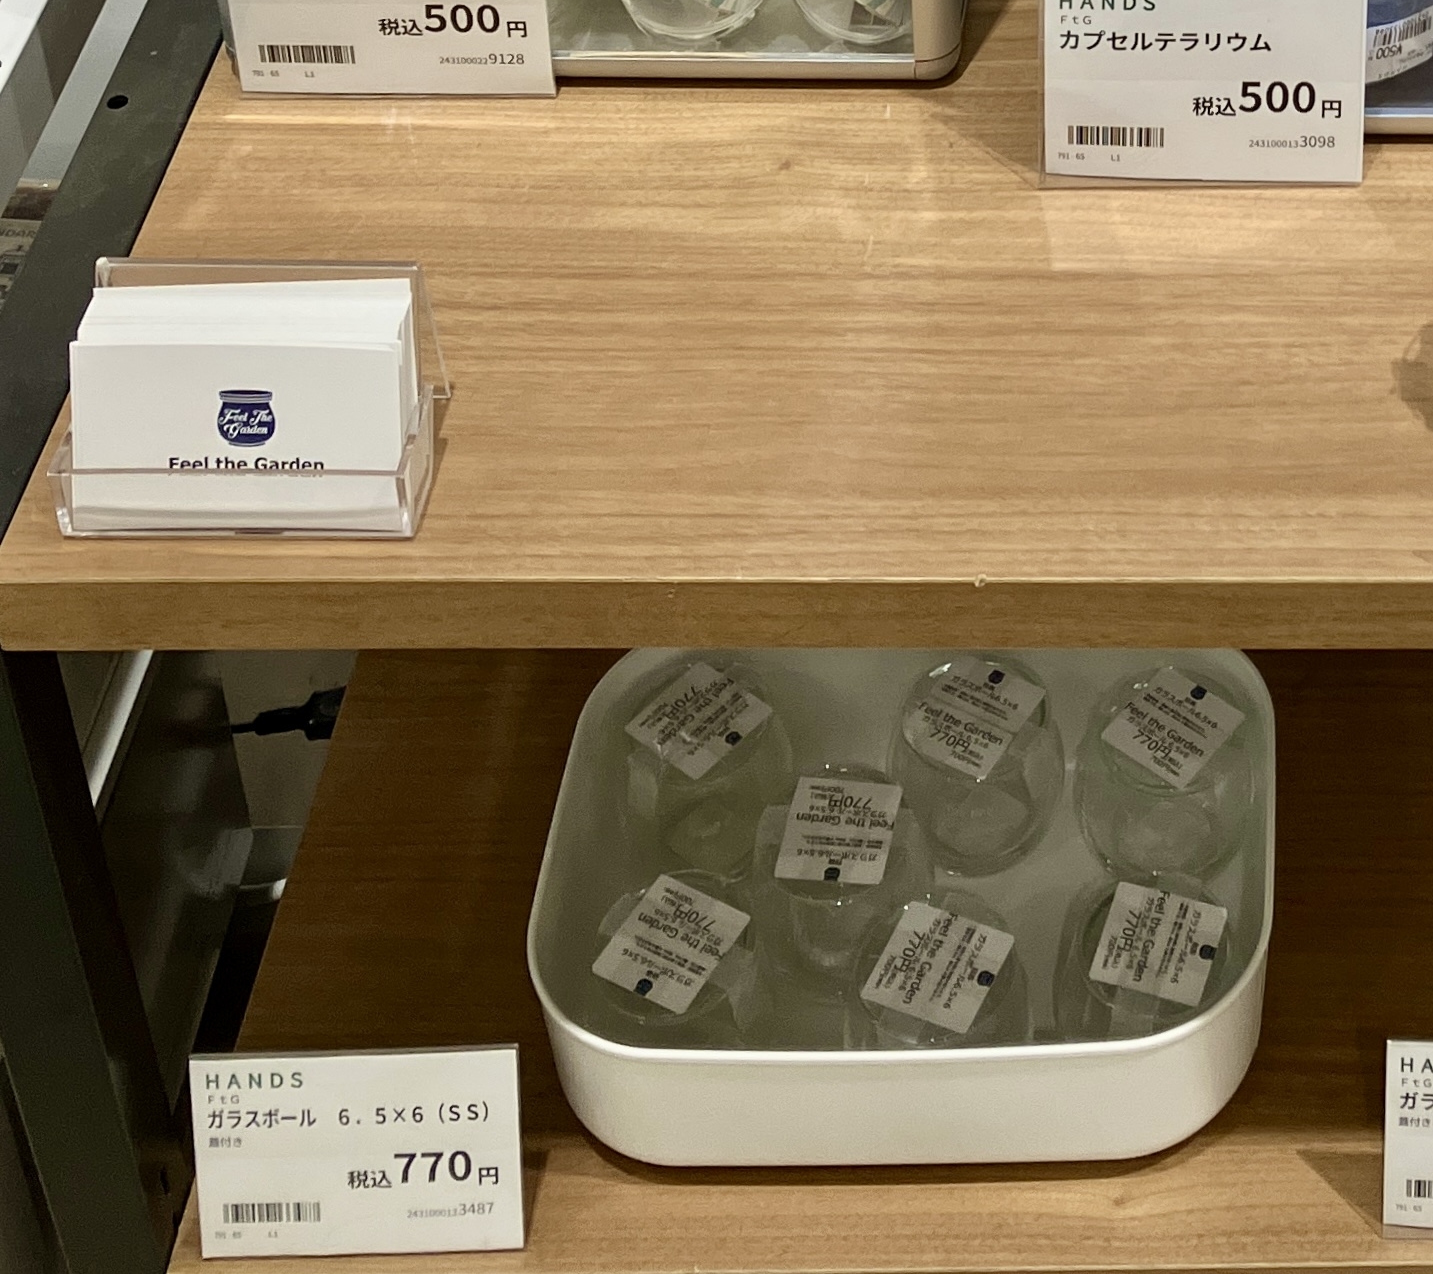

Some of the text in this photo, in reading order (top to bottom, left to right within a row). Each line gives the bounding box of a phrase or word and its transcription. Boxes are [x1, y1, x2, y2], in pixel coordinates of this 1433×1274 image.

[1060, 15, 1092, 25] FtG
[1059, 30, 1271, 53] カプセルテラリウム
[218, 408, 273, 426] Feel The
[223, 424, 268, 439] Garden
[169, 457, 324, 472] Feel the Garden
[919, 702, 1004, 746] Feel the Garden
[1125, 701, 1205, 759] Feel the Garden
[796, 813, 894, 831] Feel the Garden
[1132, 890, 1171, 983] Feel the Garden
[206, 1072, 304, 1090] HANDS
[1401, 1077, 1432, 1089] FtG
[208, 1095, 240, 1105] FtG
[208, 1108, 316, 1130] ガラスボール
